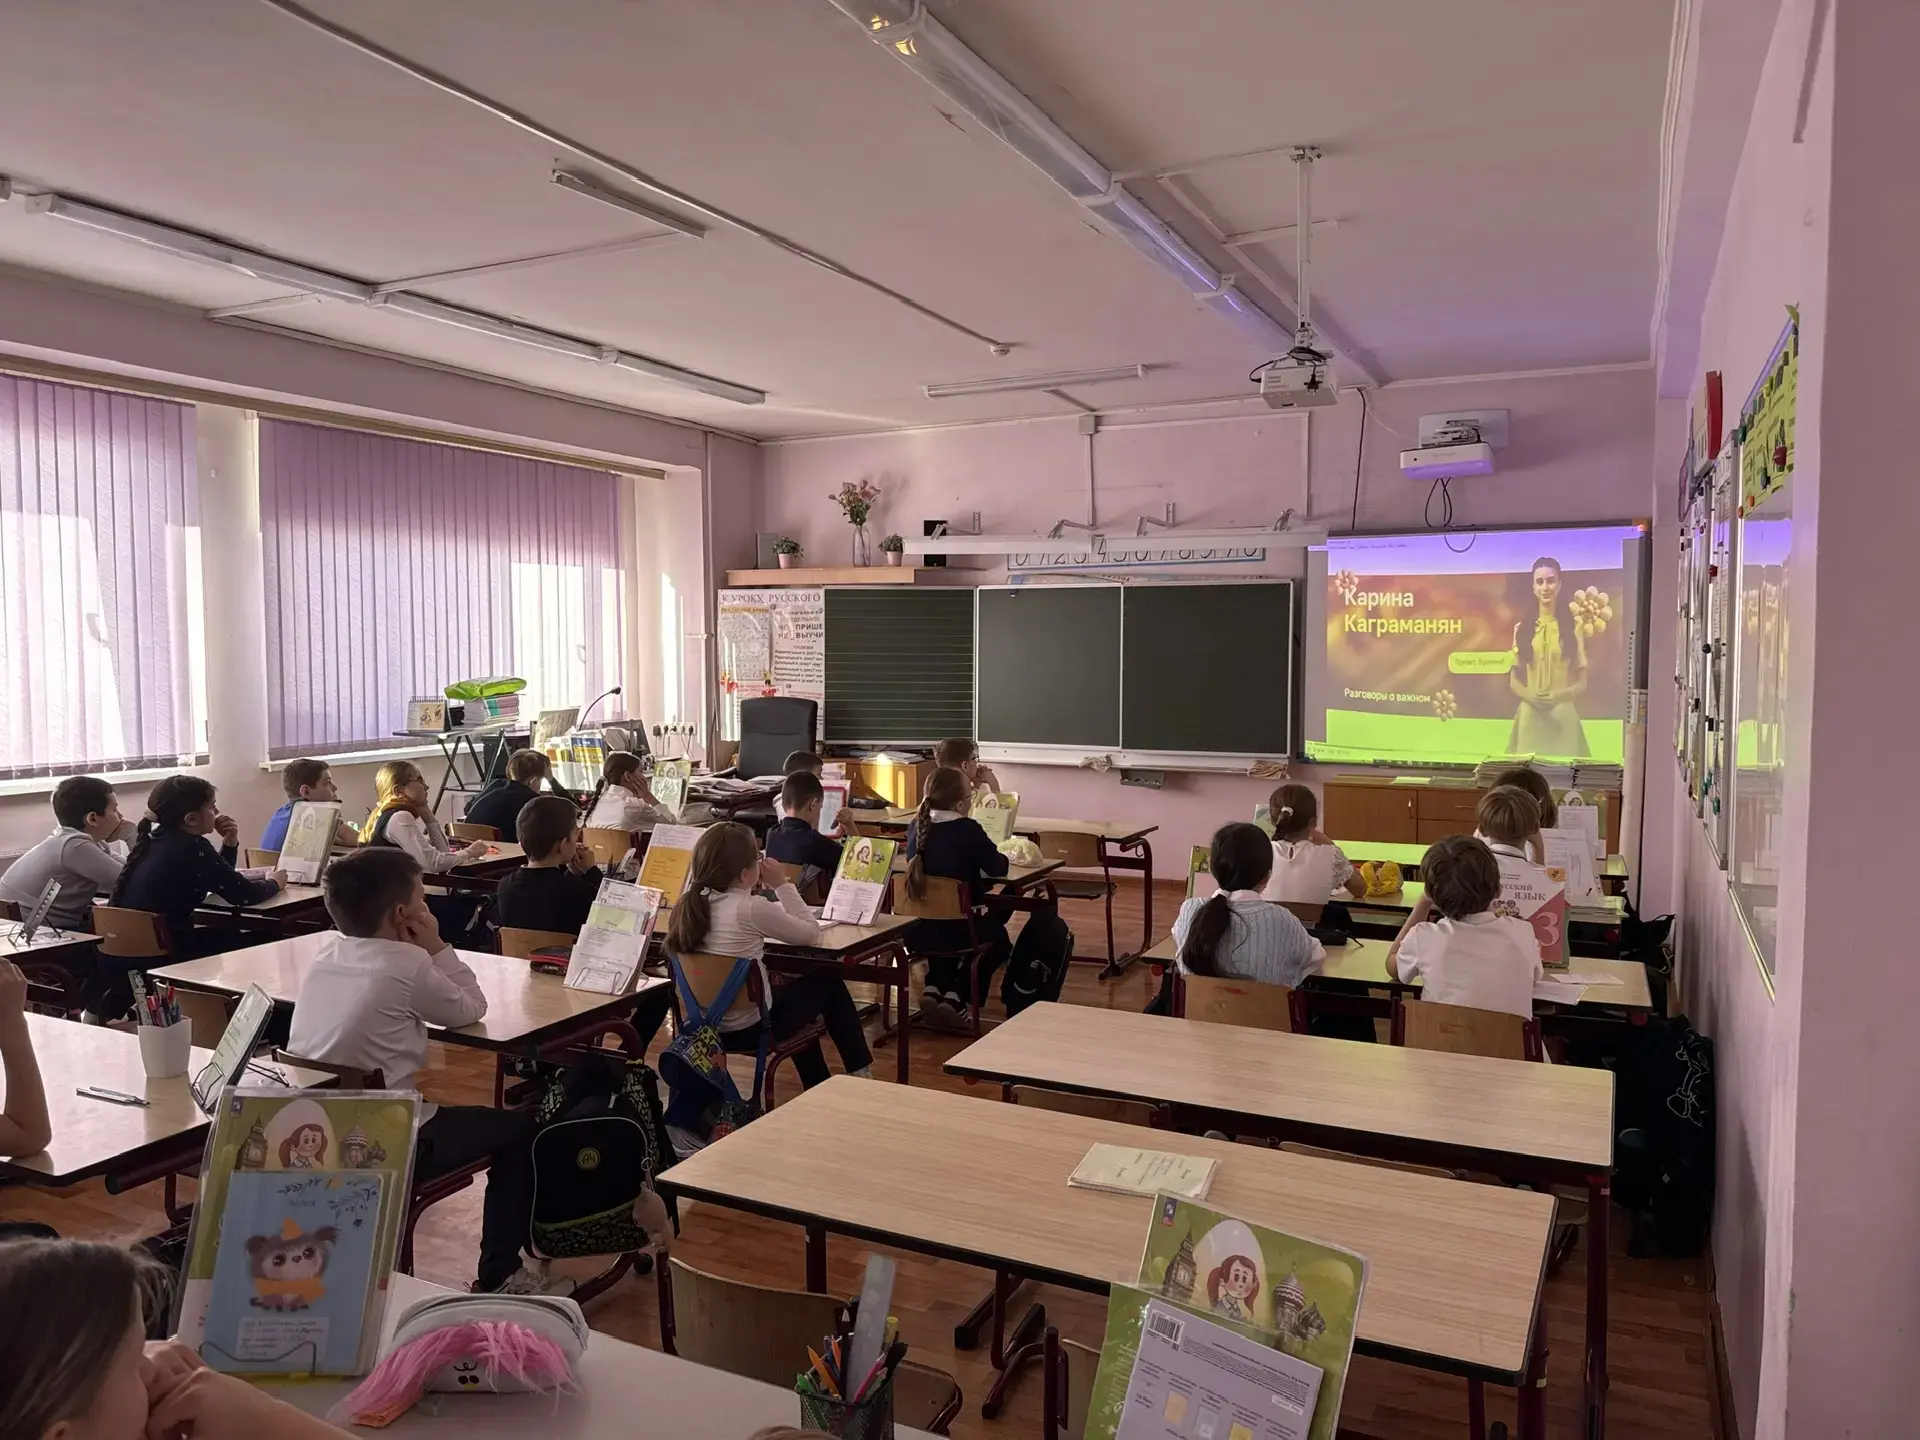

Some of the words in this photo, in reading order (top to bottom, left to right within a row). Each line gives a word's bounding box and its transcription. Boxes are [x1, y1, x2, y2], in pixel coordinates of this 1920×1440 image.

[722, 594, 728, 602] К
[731, 594, 763, 603] УРОКУ
[768, 593, 821, 603] РУССКОГО
[1344, 588, 1414, 611] Карина
[1344, 614, 1462, 638] Каграманян
[1344, 688, 1387, 702] Разговоры
[1389, 693, 1395, 701] о
[1397, 693, 1431, 703] важном
[1536, 911, 1560, 947] 3
